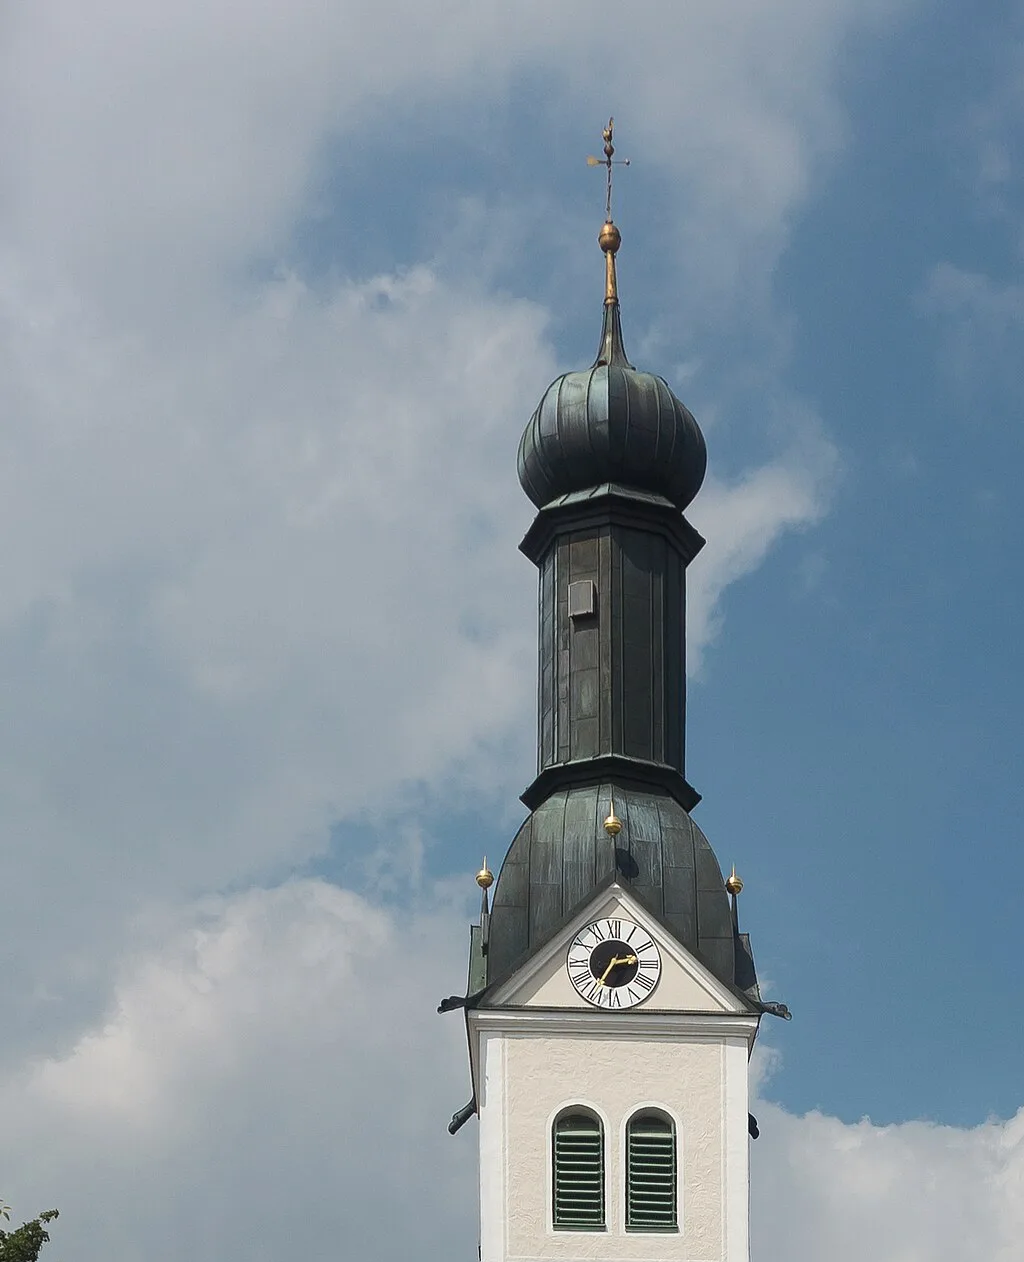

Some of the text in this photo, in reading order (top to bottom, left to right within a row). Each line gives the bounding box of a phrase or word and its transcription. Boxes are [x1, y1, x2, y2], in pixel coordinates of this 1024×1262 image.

[588, 923, 605, 943] XI
[607, 921, 621, 939] XII
[627, 927, 637, 942] I
[574, 937, 593, 953] X
[636, 941, 653, 954] II
[640, 960, 658, 969] III
[627, 987, 641, 1004] V
